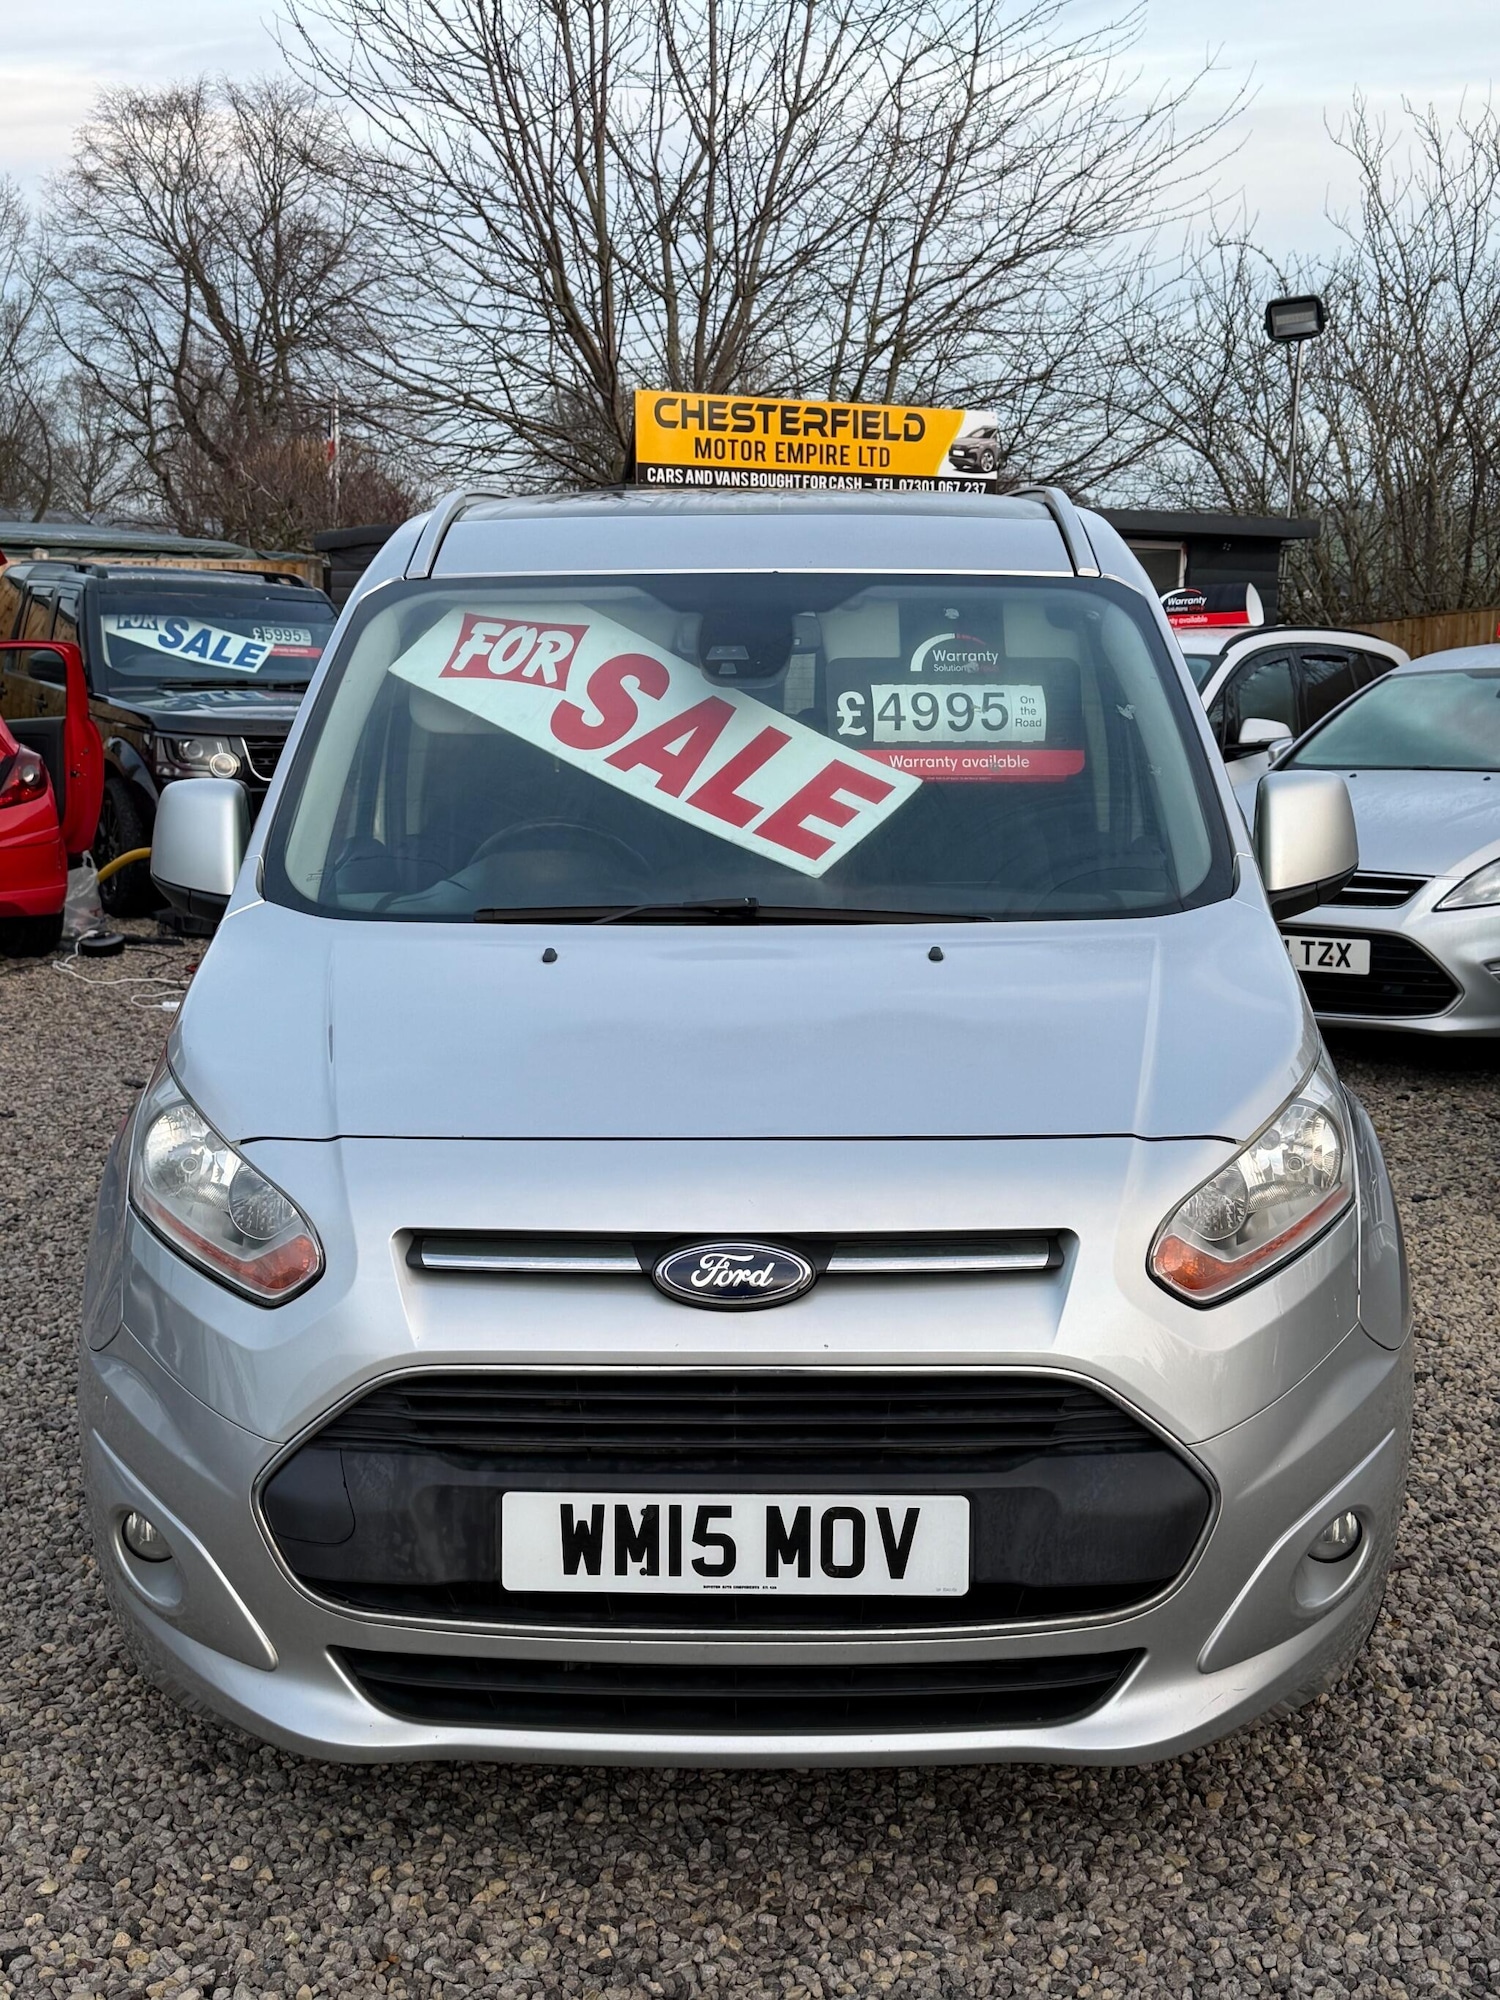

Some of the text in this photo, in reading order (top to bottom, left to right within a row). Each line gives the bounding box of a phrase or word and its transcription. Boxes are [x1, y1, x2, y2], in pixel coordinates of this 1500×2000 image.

[654, 397, 926, 442] CHESTERFIELD
[694, 437, 890, 468] MOTOR EMPIRE LTD
[647, 467, 683, 484] CARS
[685, 469, 713, 485] AND
[713, 470, 749, 487] VANS
[750, 472, 801, 488] BOUGHT
[802, 474, 827, 489] FOR
[828, 476, 862, 490] CASH
[964, 482, 987, 495] 237
[1167, 597, 1207, 606] Warranty
[158, 617, 267, 668] SALE
[932, 649, 999, 665] Warranty
[836, 690, 1009, 736] £4995
[1020, 695, 1035, 705] On
[1020, 706, 1037, 717] the
[1015, 717, 1042, 728] Road
[451, 621, 896, 861] FOR SALE
[889, 754, 1030, 772] Warranty available
[1300, 940, 1352, 968] TZX
[690, 1253, 776, 1288] Ford
[559, 1503, 921, 1580] WM15 MOV
